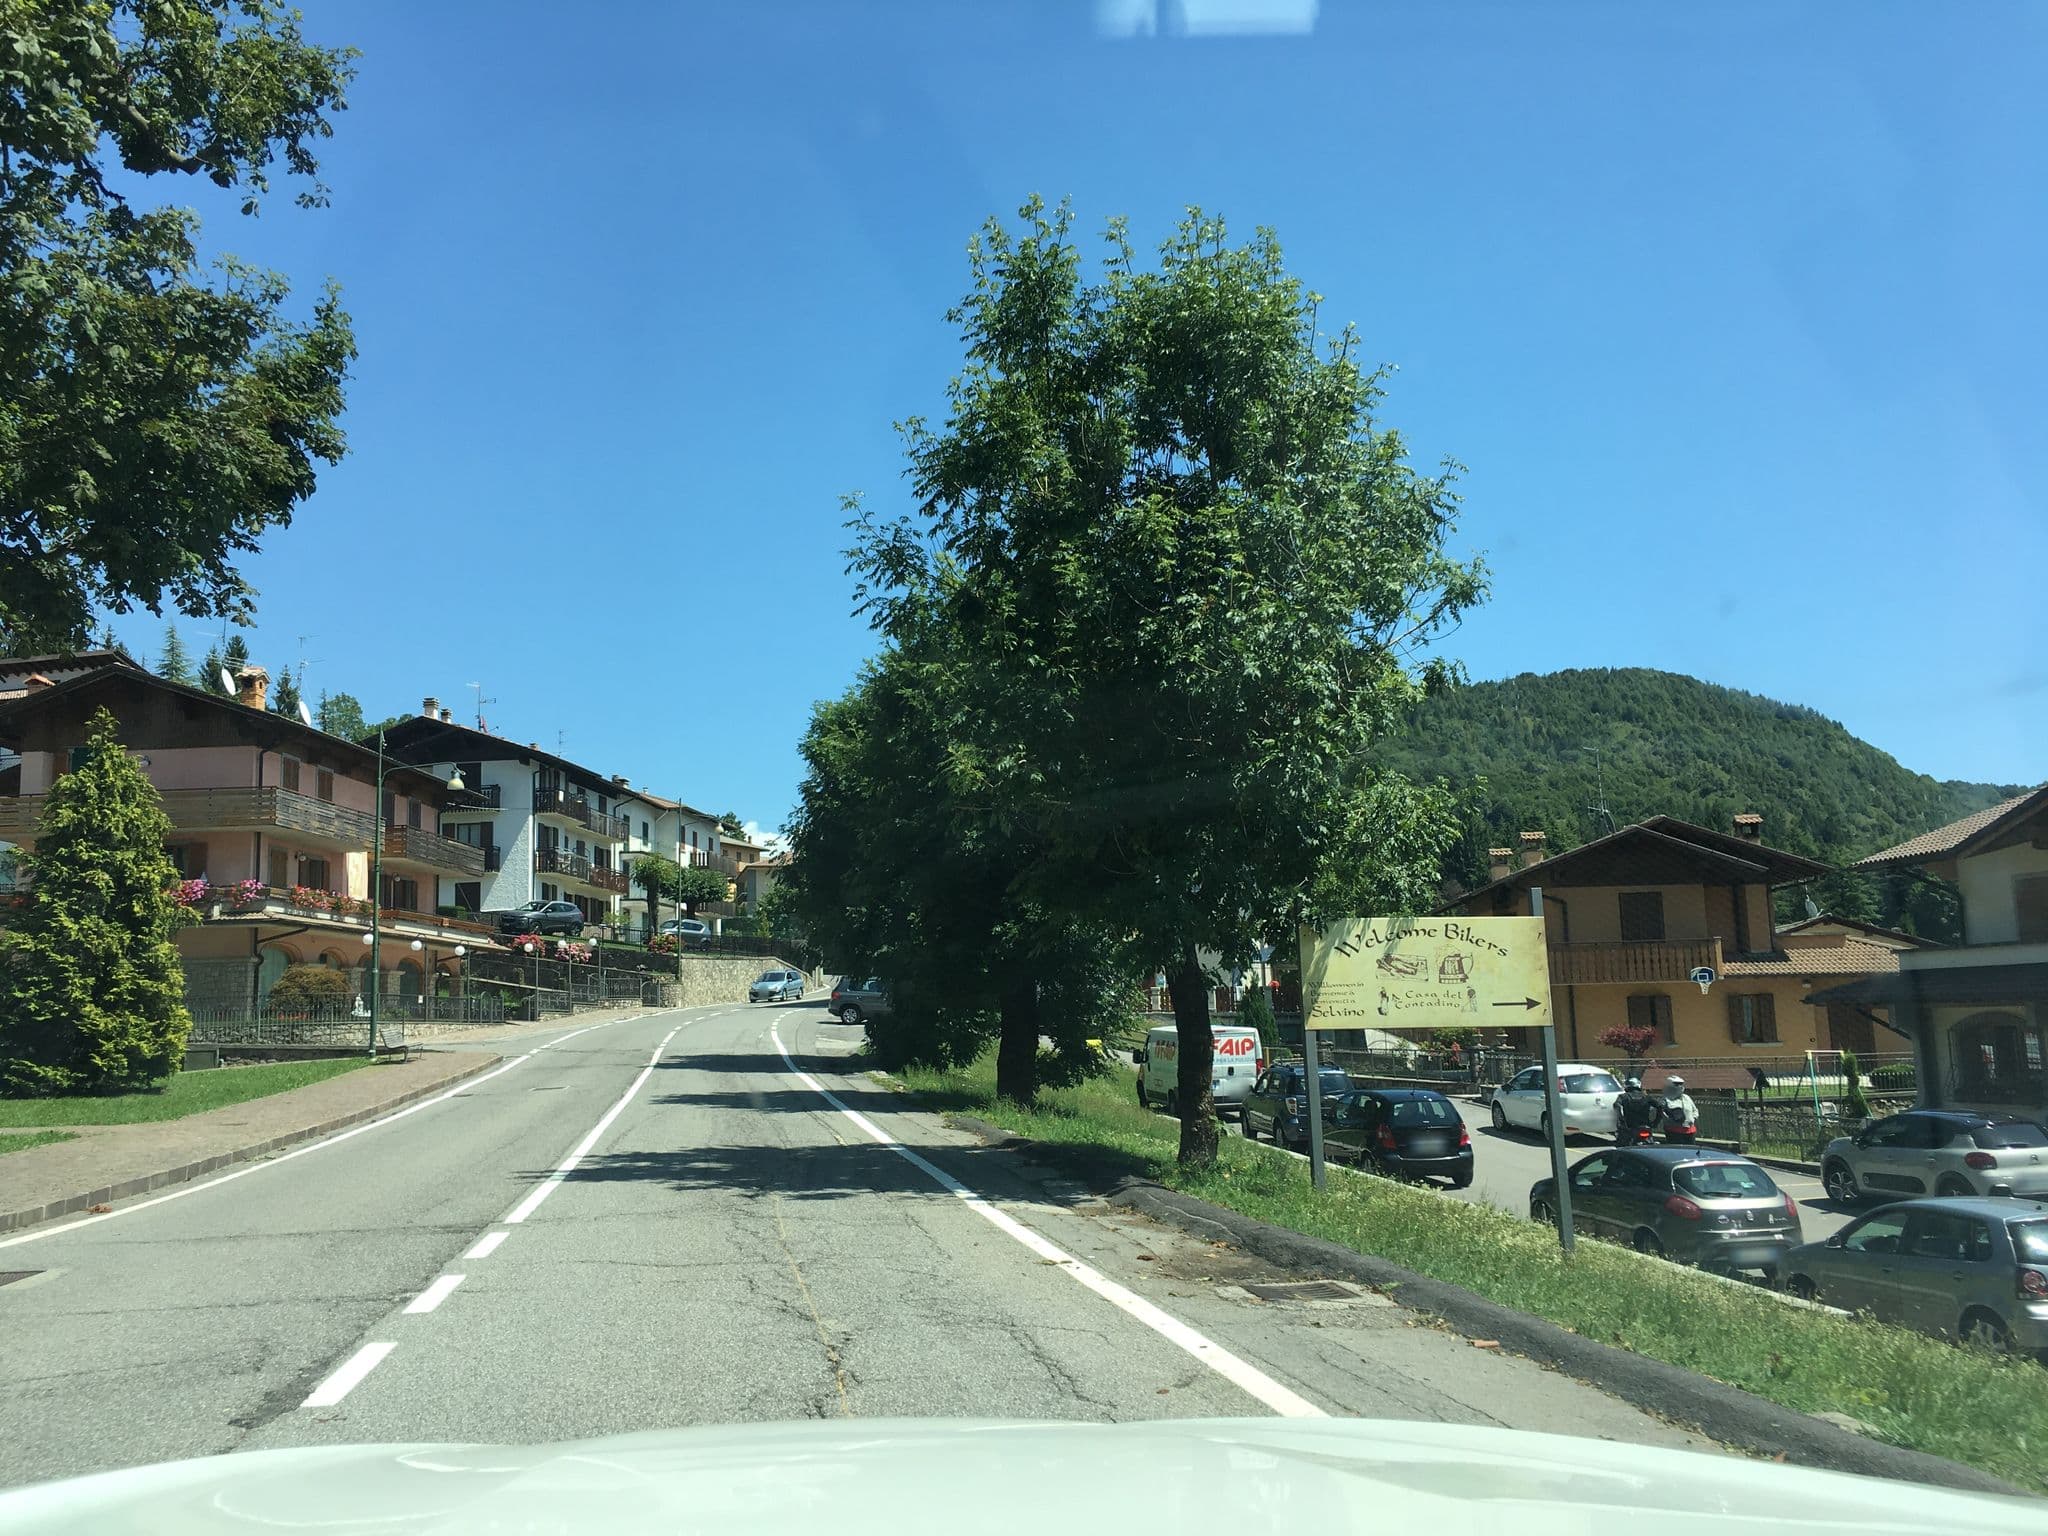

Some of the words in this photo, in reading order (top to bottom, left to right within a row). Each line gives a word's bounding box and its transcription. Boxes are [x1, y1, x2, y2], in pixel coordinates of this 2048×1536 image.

[1334, 928, 1438, 958] Welcome
[1444, 923, 1509, 957] Bikers
[1405, 990, 1438, 999] Casa
[1443, 990, 1462, 999] del
[1395, 999, 1461, 1009] Contadino
[1312, 1005, 1365, 1018] Selvino
